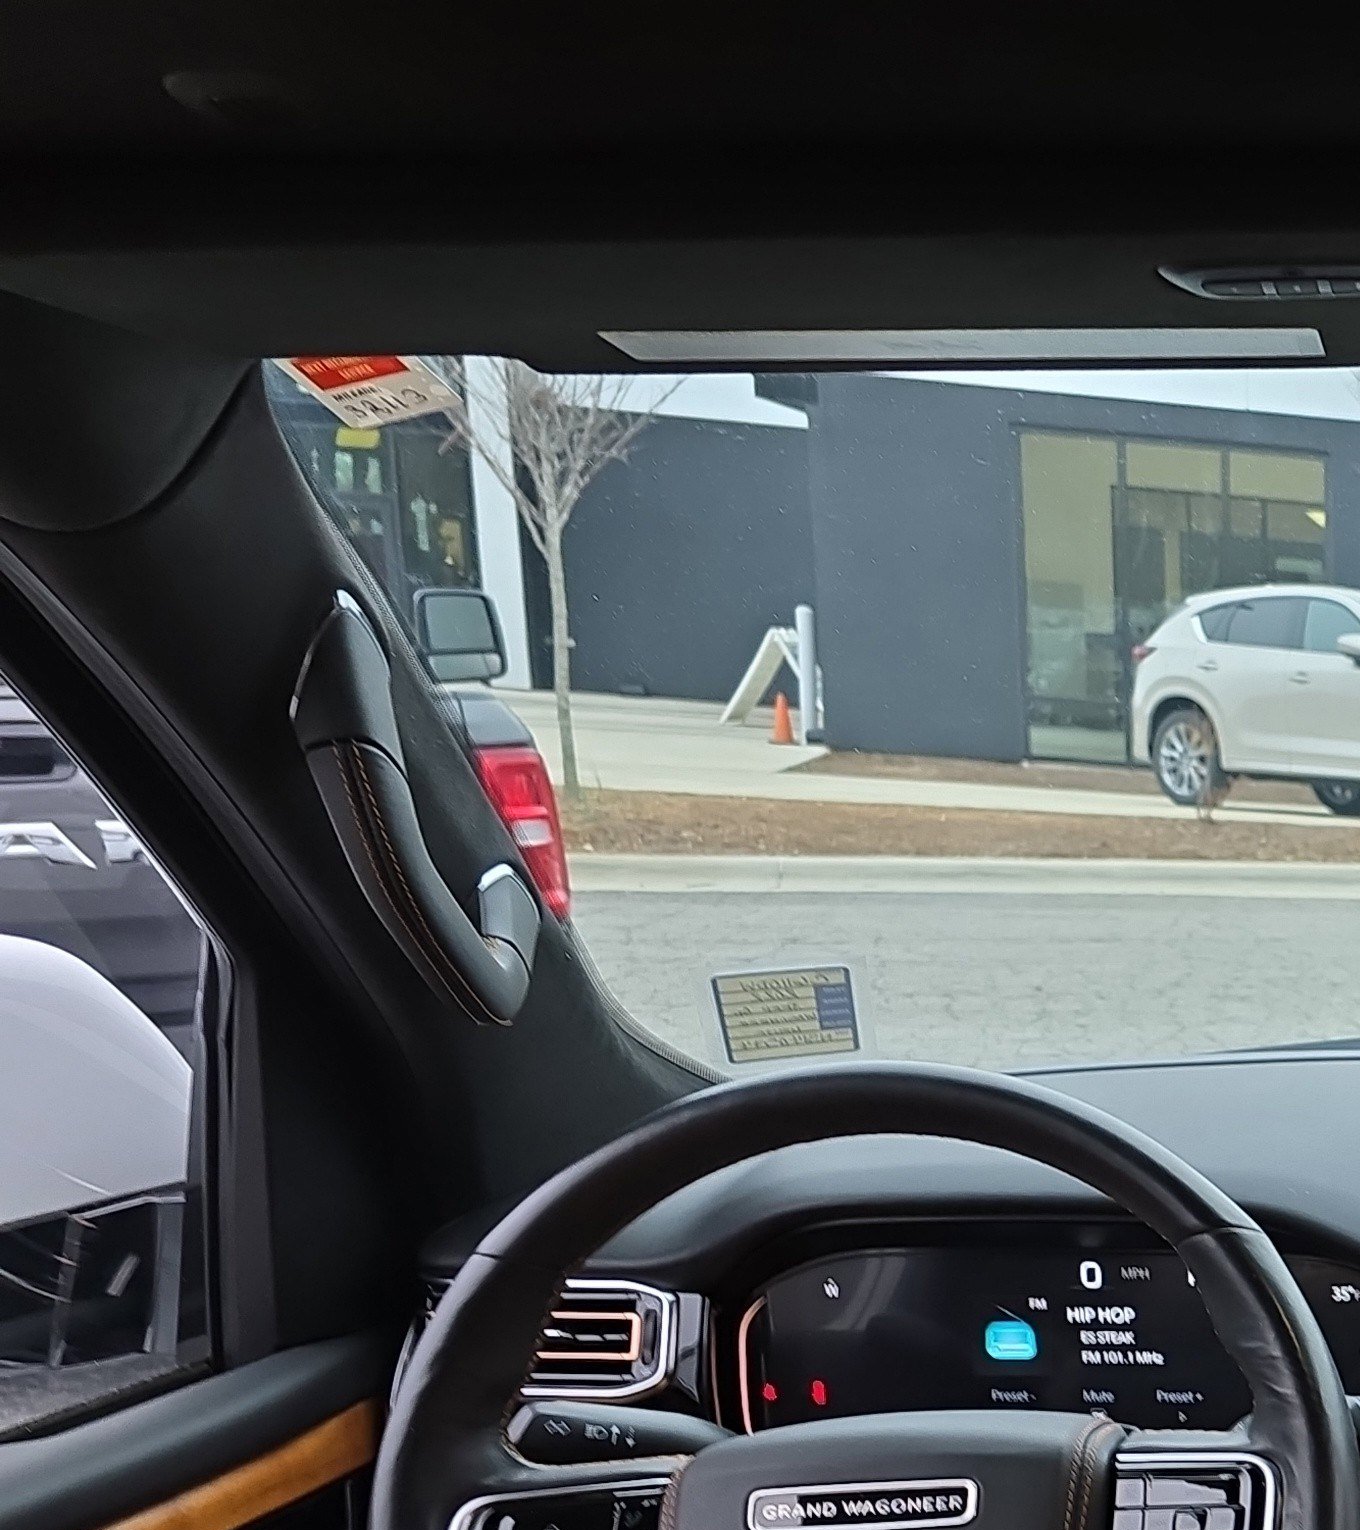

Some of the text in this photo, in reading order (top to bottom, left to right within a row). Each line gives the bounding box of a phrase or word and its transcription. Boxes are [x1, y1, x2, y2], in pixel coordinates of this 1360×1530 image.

[1120, 1266, 1150, 1281] MPH
[1028, 1296, 1048, 1311] FM
[1065, 1306, 1136, 1325] HIP HOP
[1081, 1350, 1102, 1365] FM
[1102, 1350, 1135, 1366] 101.1
[1082, 1388, 1115, 1403] Mute
[762, 1494, 964, 1521] GRAND WAGONEER
